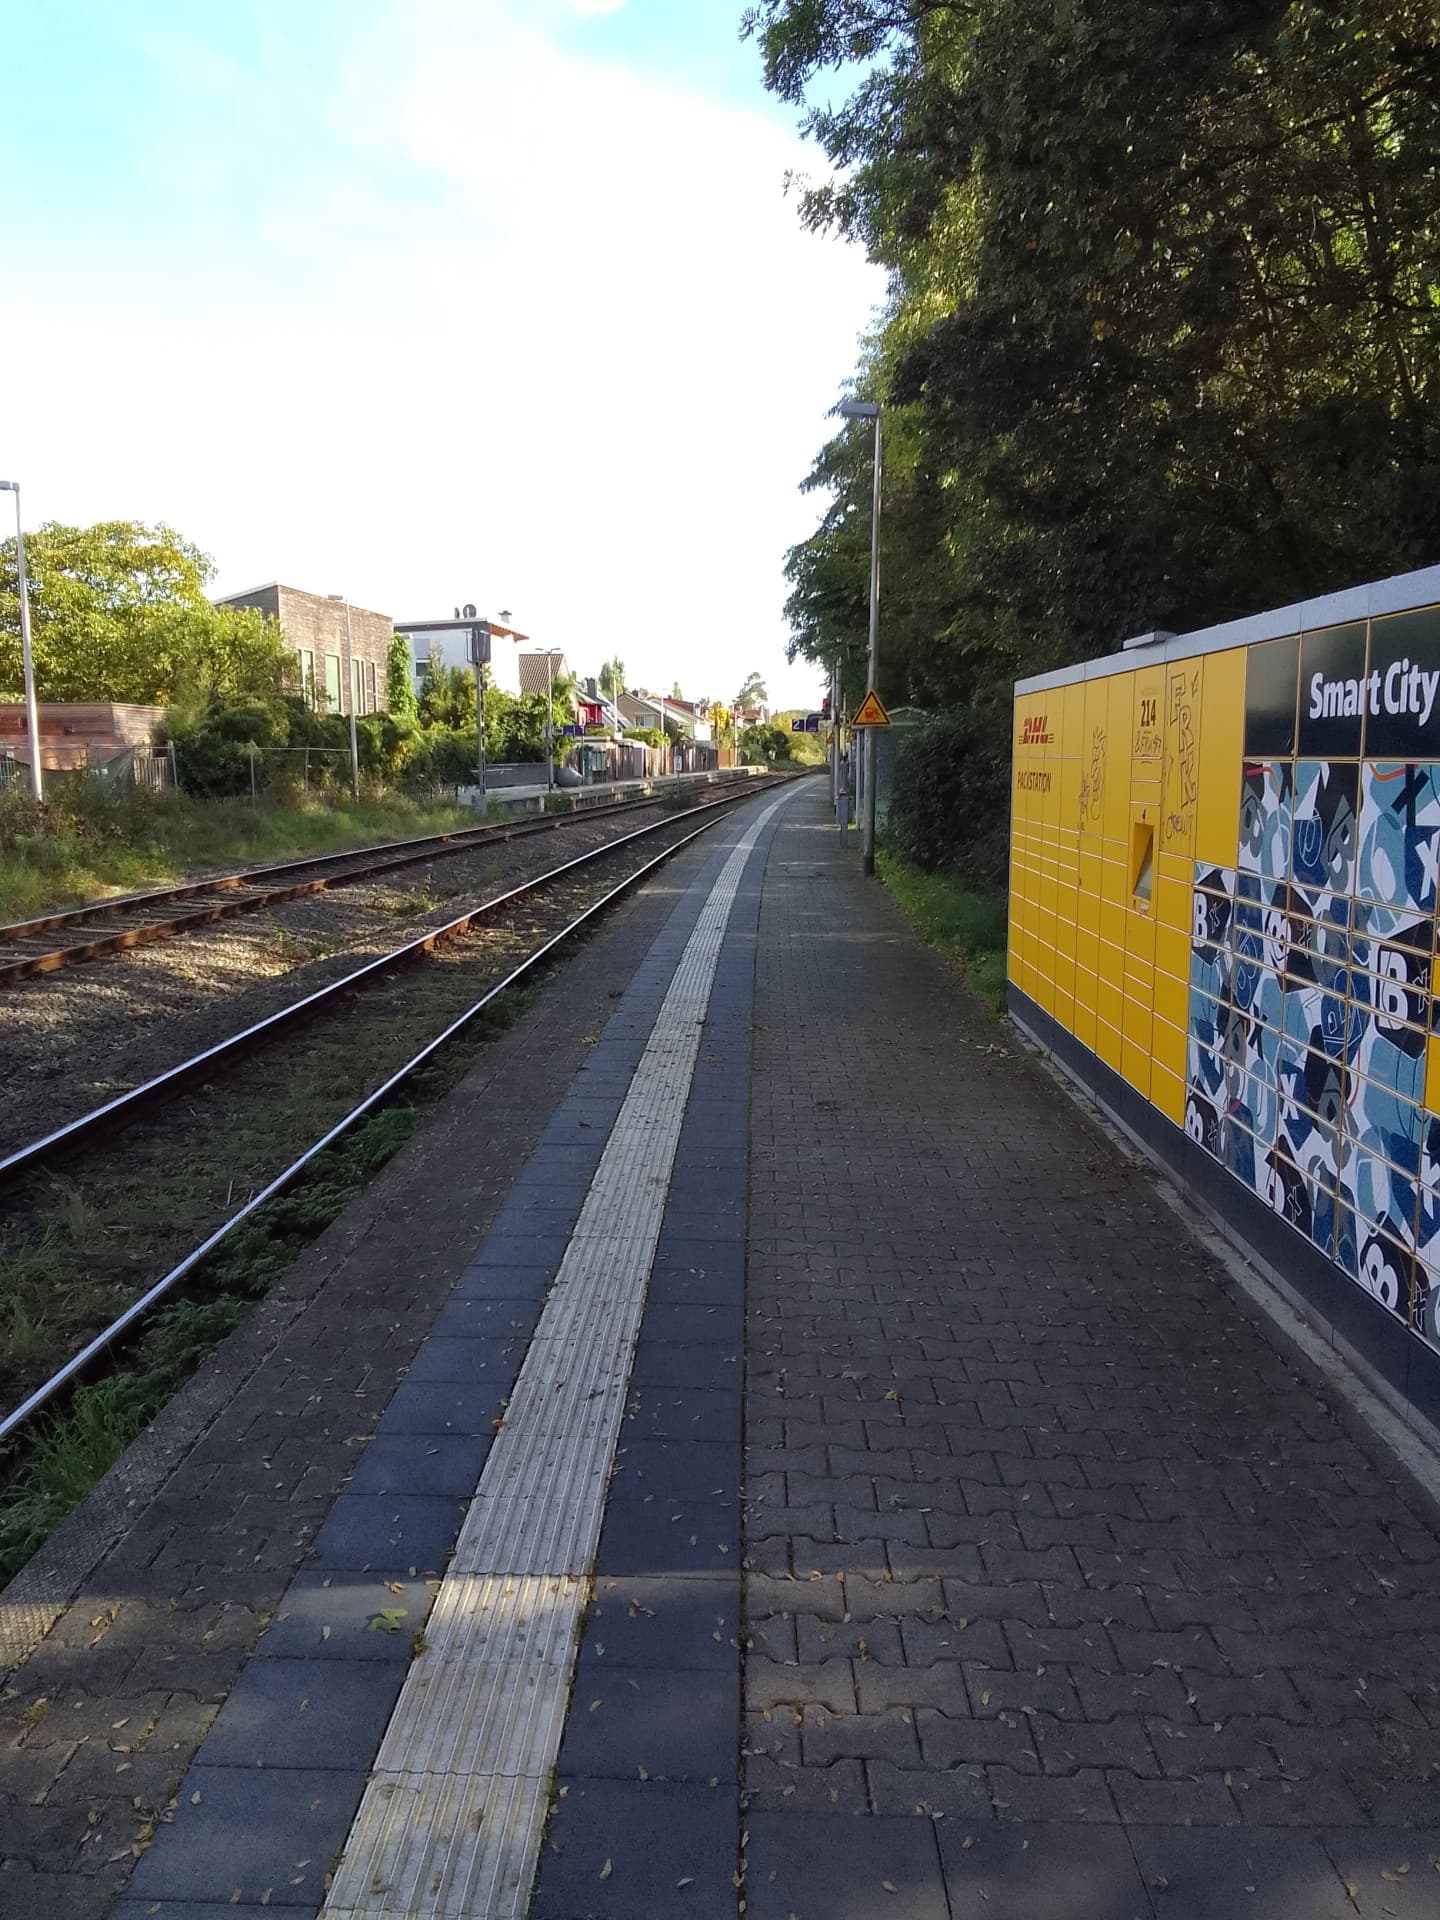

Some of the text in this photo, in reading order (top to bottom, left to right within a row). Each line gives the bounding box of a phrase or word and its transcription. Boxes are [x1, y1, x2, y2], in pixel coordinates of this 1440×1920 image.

[1309, 658, 1440, 727] Smart City
[793, 719, 801, 731] 2
[1140, 698, 1157, 728] 214
[1020, 715, 1051, 744] DHL
[1017, 770, 1051, 792] PACKSTATION
